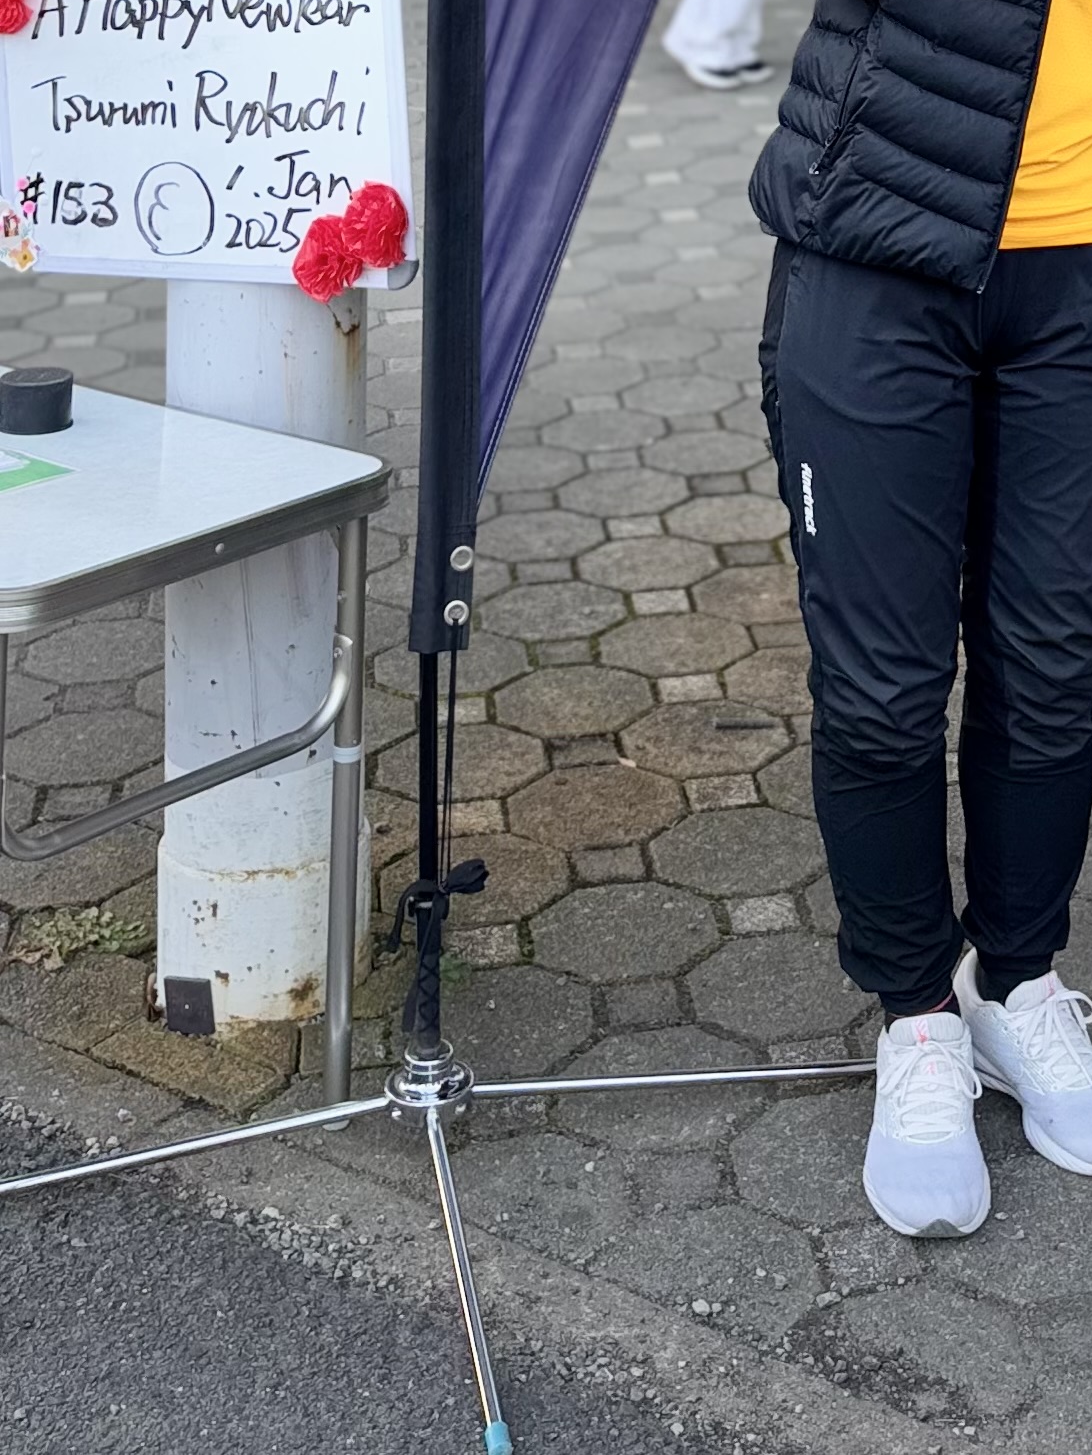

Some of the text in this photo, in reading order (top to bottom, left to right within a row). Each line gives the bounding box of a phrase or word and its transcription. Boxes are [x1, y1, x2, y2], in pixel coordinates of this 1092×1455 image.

[31, 66, 371, 144] Tsurumi Ryokuchi
[225, 208, 312, 253] 2025
